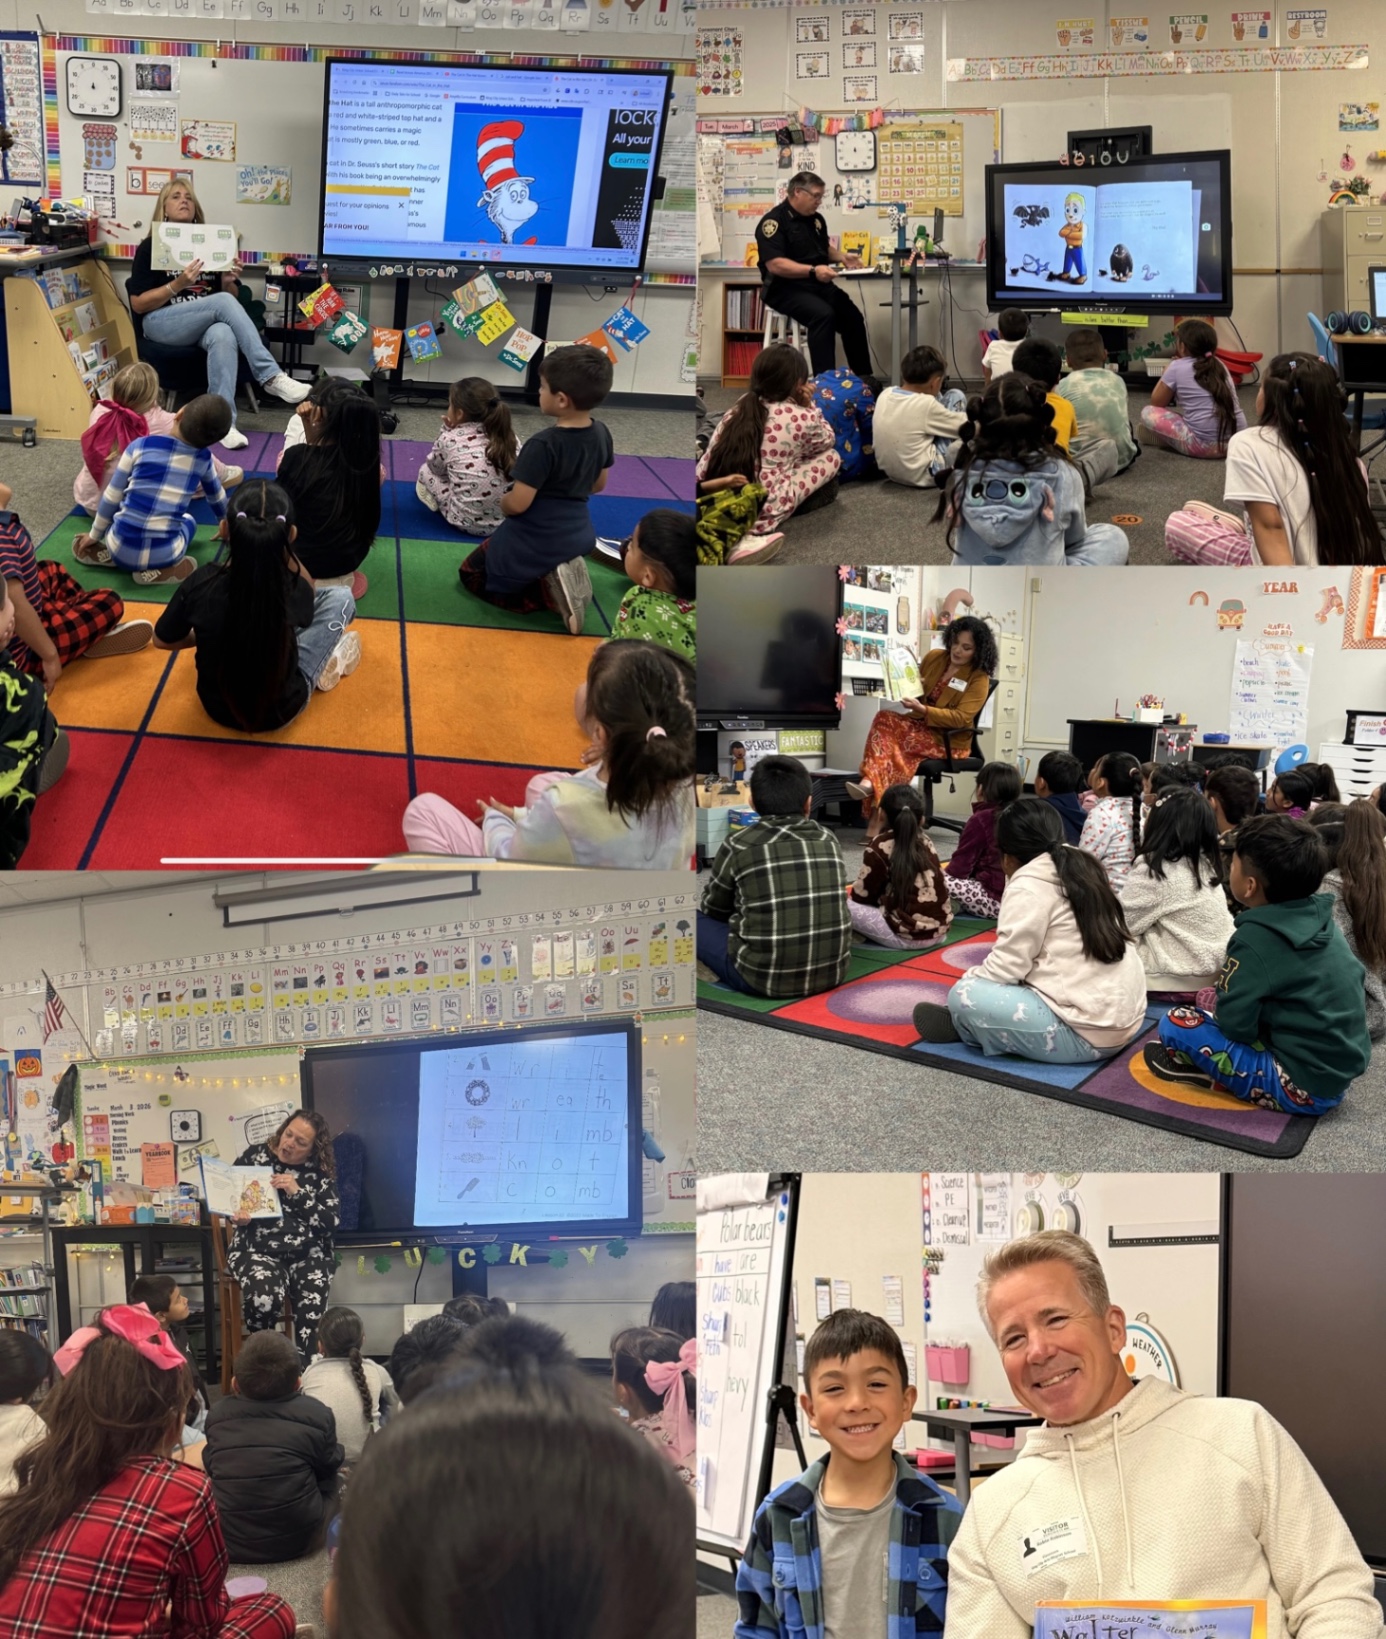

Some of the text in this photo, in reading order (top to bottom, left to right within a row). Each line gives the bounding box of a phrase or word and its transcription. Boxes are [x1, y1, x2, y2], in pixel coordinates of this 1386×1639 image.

[1174, 16, 1204, 25] PENCIL
[1238, 13, 1265, 22] DRINK
[1288, 11, 1326, 20] RESTROOM
[377, 102, 430, 111] anthropomorphic
[358, 113, 400, 122] white-striped
[340, 124, 374, 132] sometimes
[403, 127, 422, 135] magic
[342, 137, 362, 145] mostly
[613, 133, 652, 147] All your
[357, 161, 380, 169] Seuss's
[365, 173, 383, 181] being
[392, 174, 441, 183] overwhelmingly
[1263, 582, 1299, 594] YEAR
[745, 740, 777, 751] SPEAKERS
[781, 735, 823, 746] FANTASTIC
[941, 1175, 964, 1190] Science
[945, 1193, 955, 1205] PE
[720, 1210, 772, 1244] Polar bears
[458, 1248, 476, 1269] C
[509, 1243, 531, 1267] K
[578, 1244, 598, 1268] Y
[715, 1253, 757, 1274] have are
[1132, 1337, 1163, 1371] WEATHER
[1042, 1522, 1069, 1534] VISITOR
[1051, 1618, 1138, 1639] Walter
